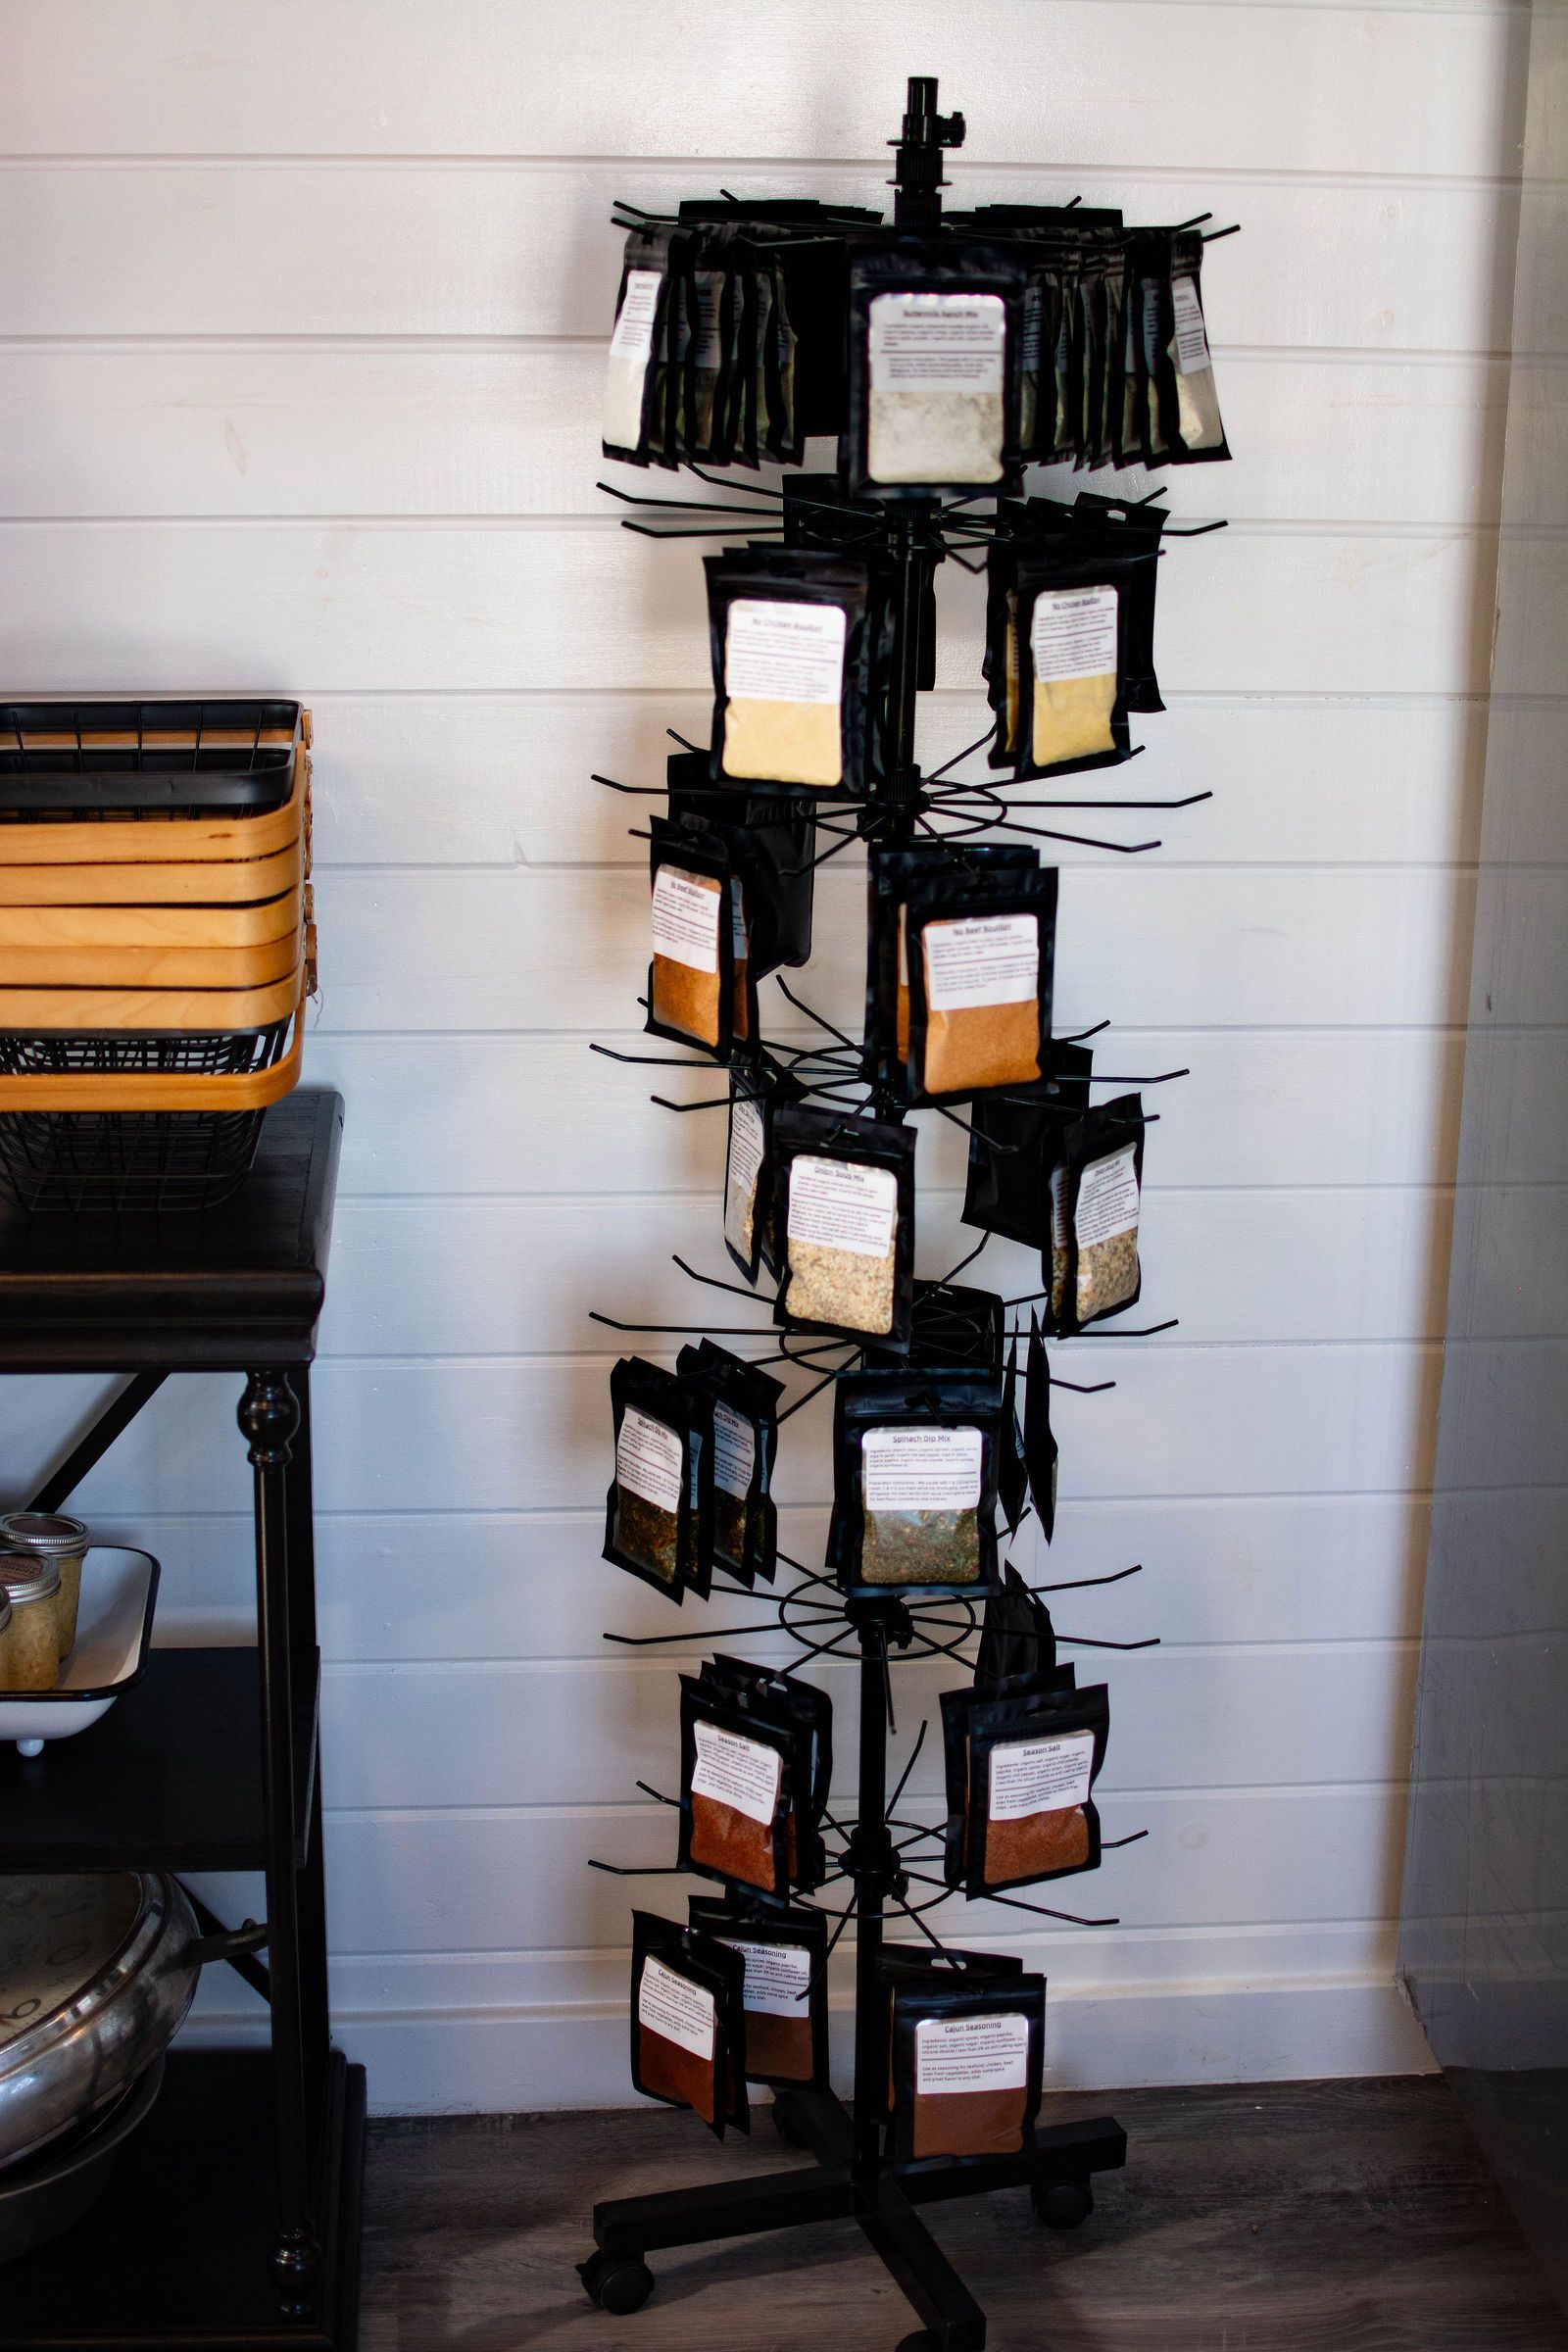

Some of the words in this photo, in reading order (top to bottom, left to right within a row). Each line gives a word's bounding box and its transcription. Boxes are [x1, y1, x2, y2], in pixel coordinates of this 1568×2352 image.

[814, 1166, 834, 1176] Onion
[718, 1735, 738, 1747] Season
[739, 1741, 751, 1752] Salt
[732, 1944, 752, 1953] Cajun
[753, 1946, 787, 1959] Seasoning
[658, 1969, 671, 1982] Cajun
[671, 1977, 697, 1996] Seasoning
[945, 2025, 964, 2034] Cajun
[966, 2022, 1002, 2031] Seasoning
